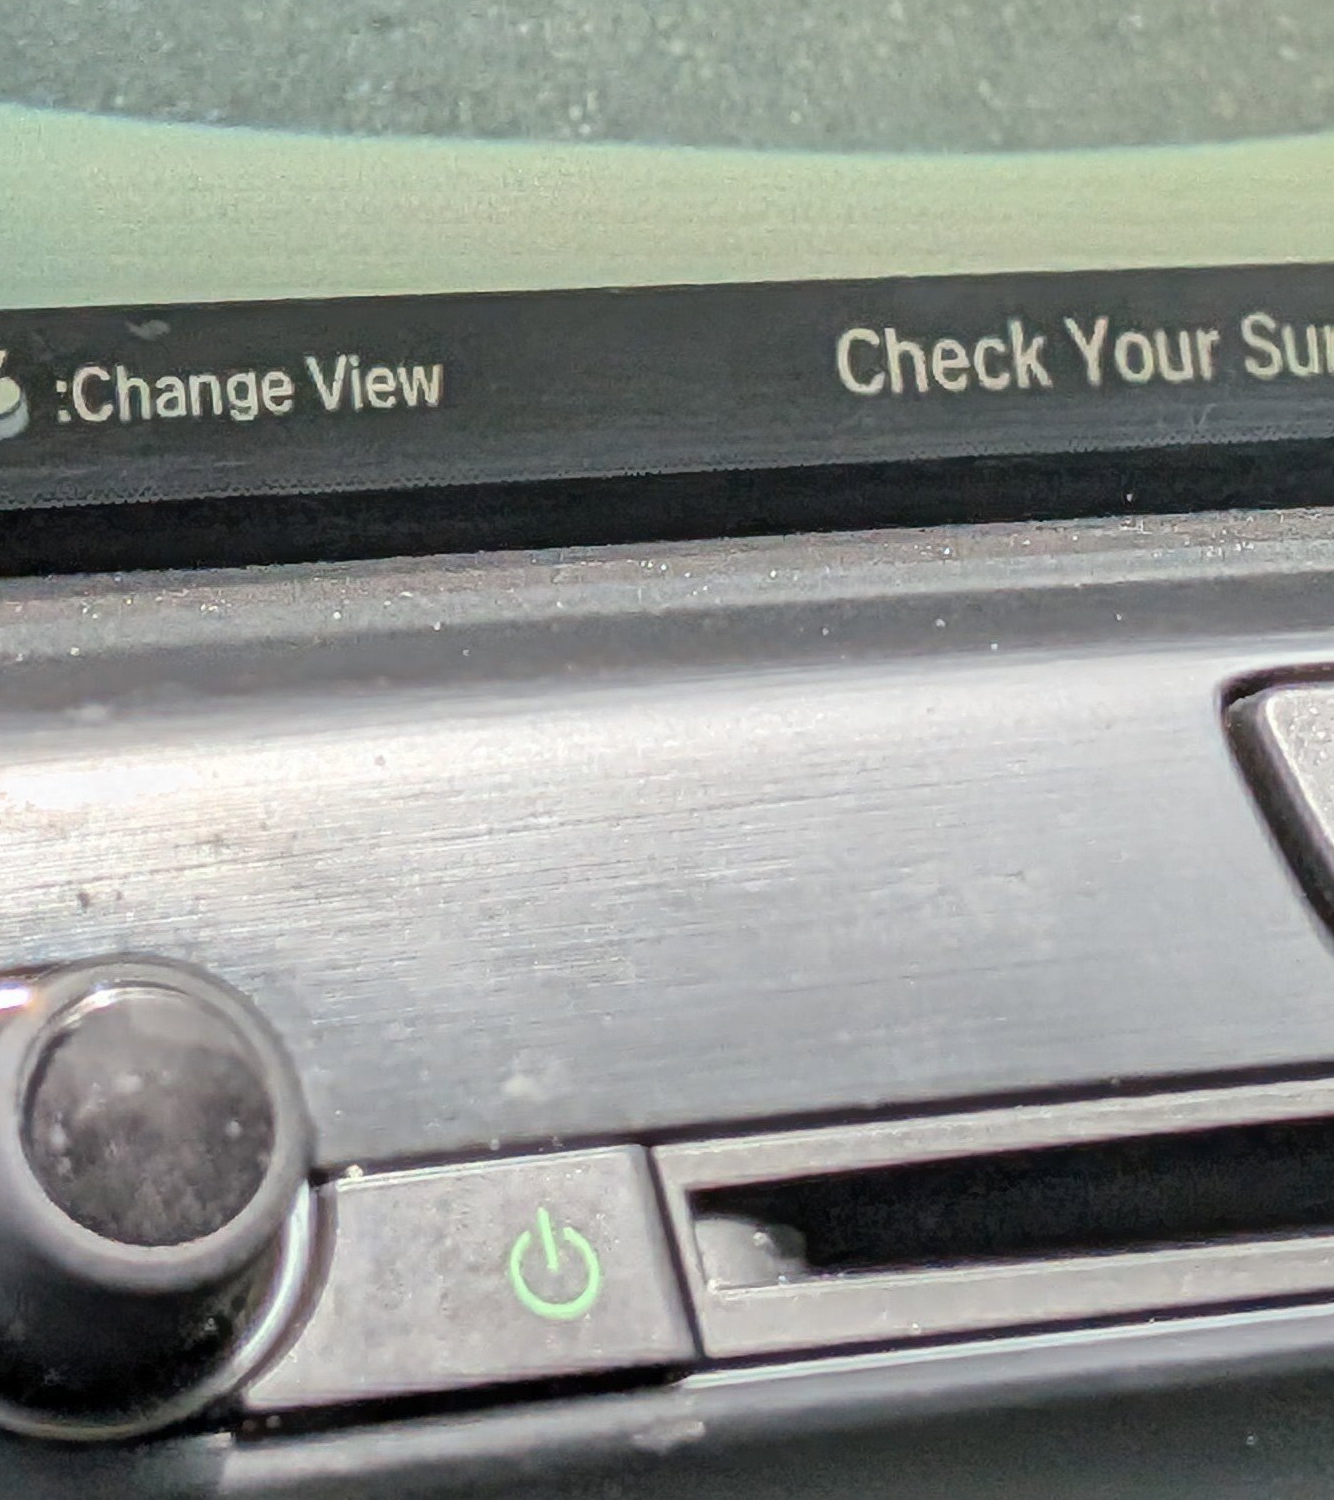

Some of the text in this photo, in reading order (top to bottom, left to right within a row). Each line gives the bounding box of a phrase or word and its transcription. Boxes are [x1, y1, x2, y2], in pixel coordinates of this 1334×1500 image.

[305, 355, 443, 409] View
[835, 318, 1053, 395] Check
[1064, 315, 1221, 386] Your
